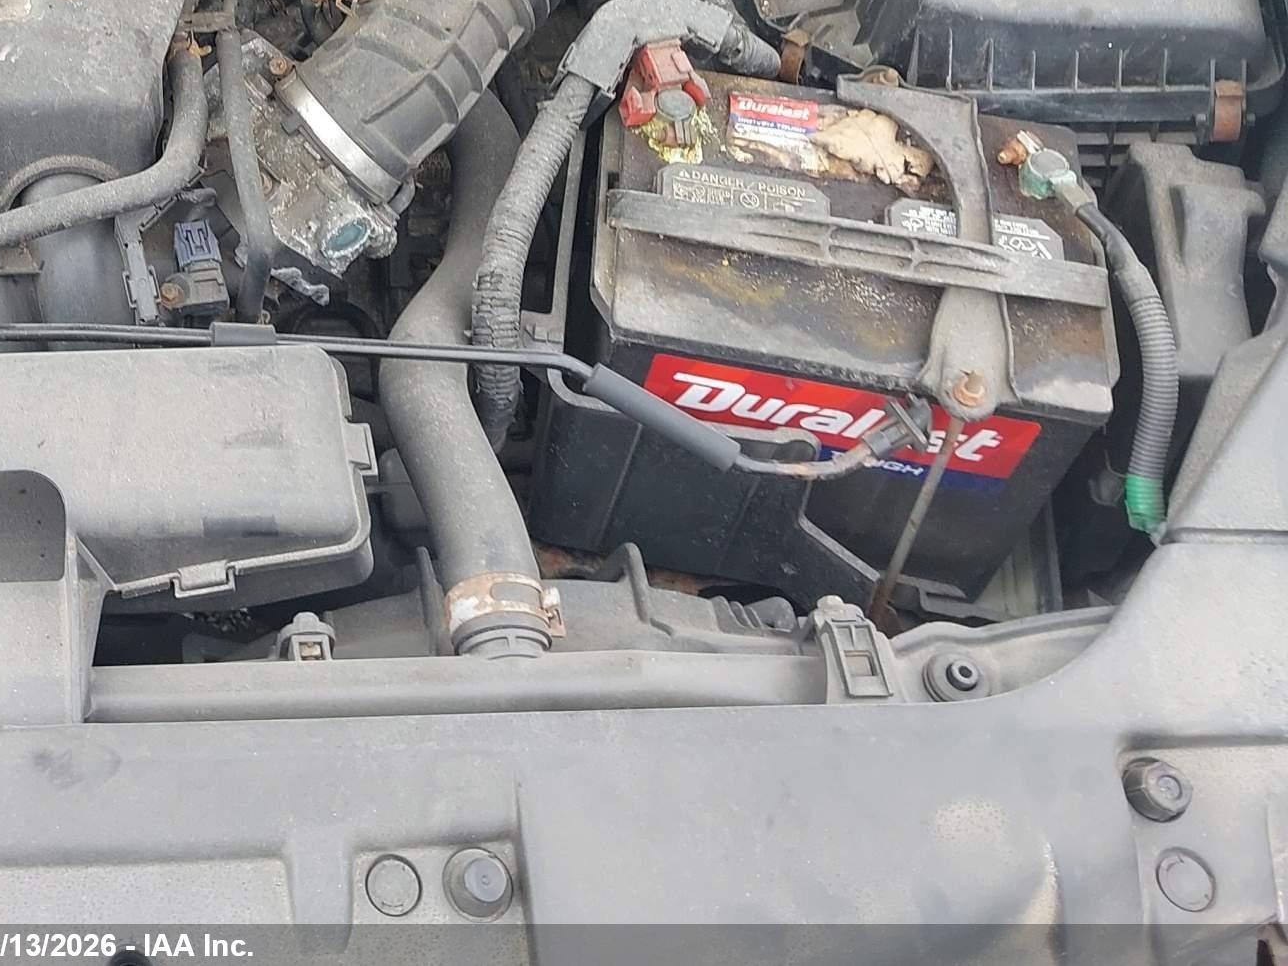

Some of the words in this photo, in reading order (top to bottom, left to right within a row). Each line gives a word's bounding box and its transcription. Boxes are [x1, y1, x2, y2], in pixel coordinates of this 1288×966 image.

[738, 97, 809, 119] Duralast
[691, 170, 745, 188] DANGER
[758, 181, 806, 198] POISON
[672, 371, 1004, 463] Duralst
